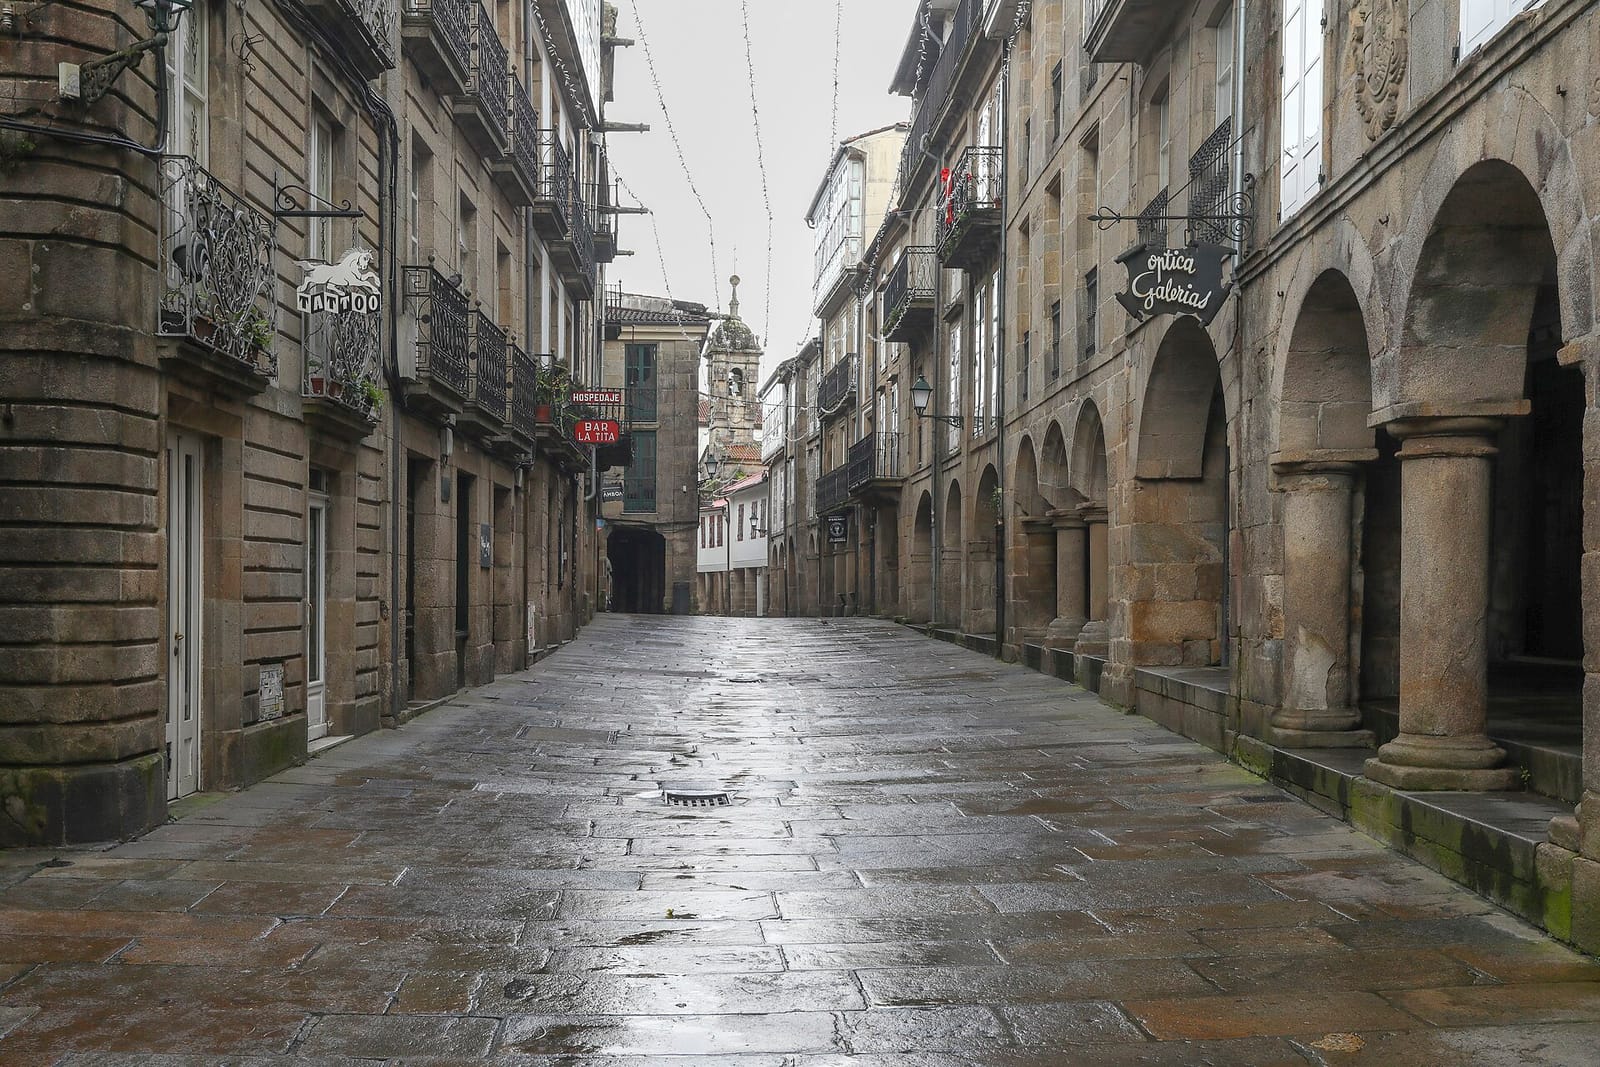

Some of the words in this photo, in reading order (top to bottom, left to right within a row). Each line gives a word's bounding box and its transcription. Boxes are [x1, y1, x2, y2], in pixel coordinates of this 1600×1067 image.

[1147, 250, 1196, 283] optica
[1131, 271, 1212, 310] Galerias
[298, 294, 379, 312] TATTOO
[573, 393, 620, 402] HOSPEDAJE
[584, 423, 608, 431] BAR
[578, 432, 591, 441] LA
[595, 432, 615, 441] TITA
